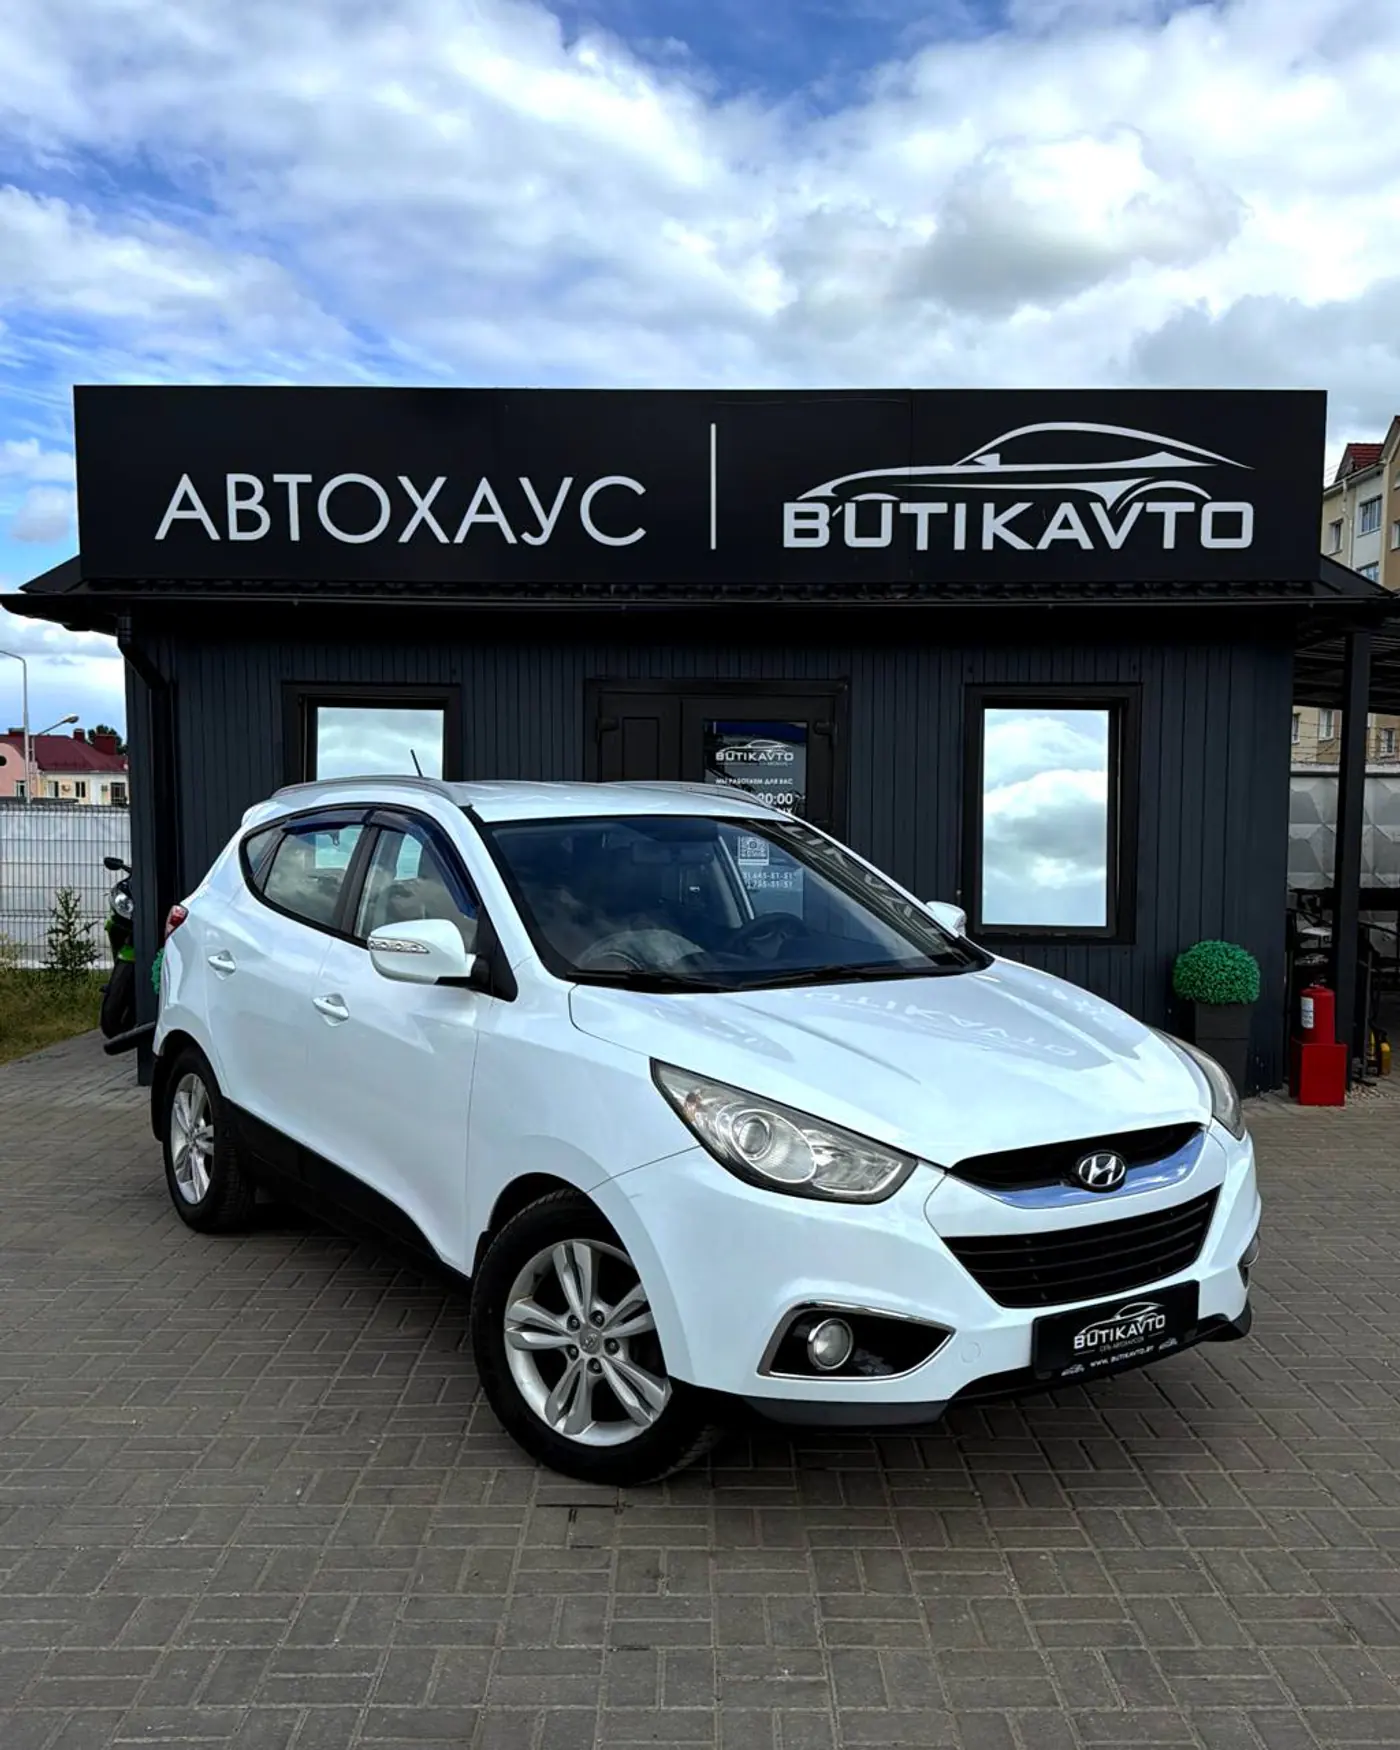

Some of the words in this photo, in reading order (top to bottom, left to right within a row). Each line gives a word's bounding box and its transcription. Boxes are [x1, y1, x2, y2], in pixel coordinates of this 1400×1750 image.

[155, 473, 646, 547] АВТОХАУС
[783, 500, 1255, 550] BUTIKAVTO
[715, 751, 794, 761] BUTIKAVTO
[1074, 1314, 1165, 1349] BUTIKAVTO
